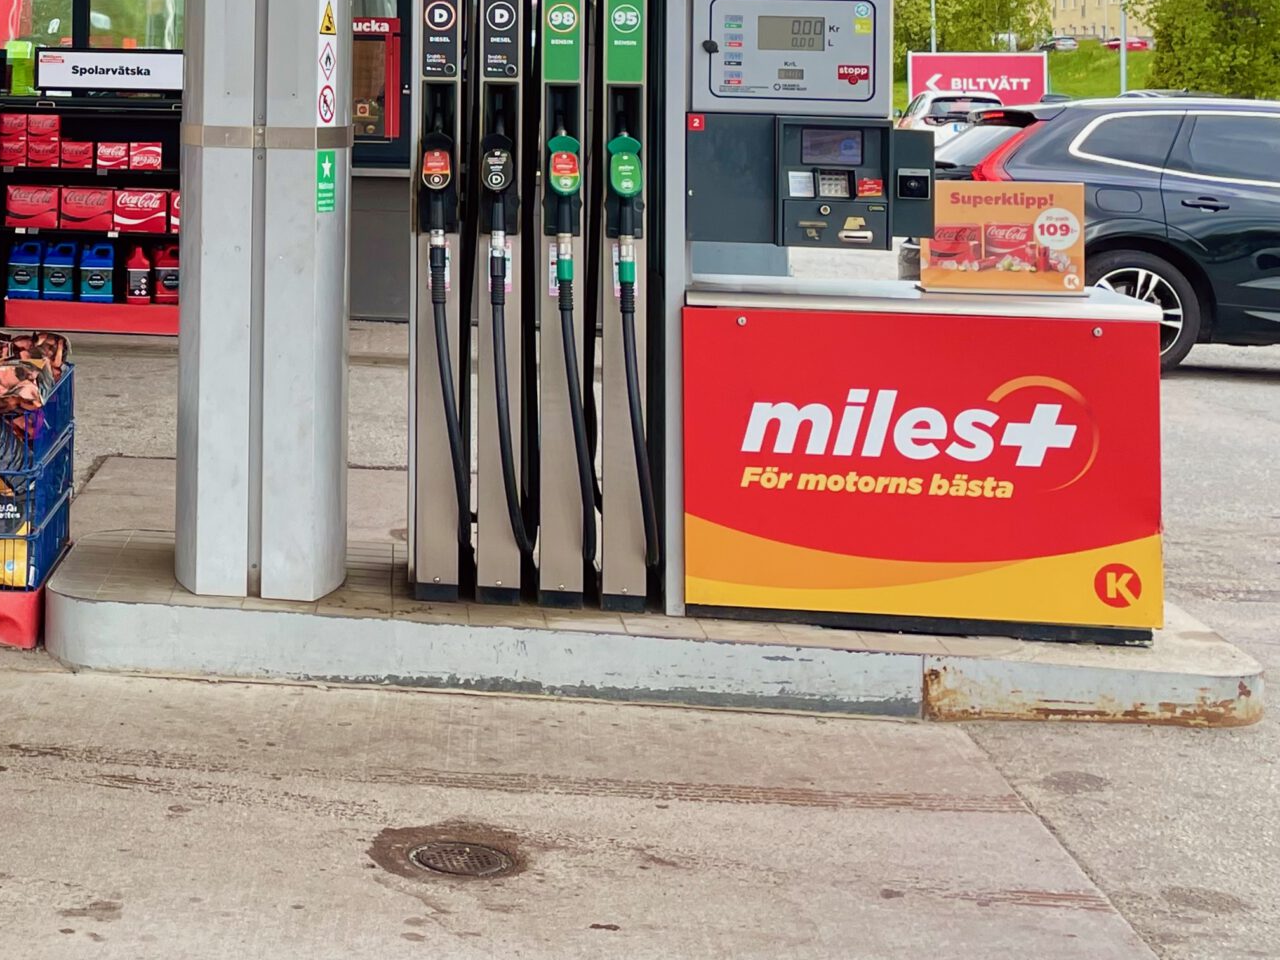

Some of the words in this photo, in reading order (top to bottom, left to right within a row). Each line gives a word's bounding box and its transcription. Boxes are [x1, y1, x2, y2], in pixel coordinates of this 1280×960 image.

[434, 9, 448, 23] D
[494, 9, 509, 23] D
[550, 11, 575, 26] 98
[613, 11, 638, 26] 95
[353, 19, 390, 32] ucka
[828, 25, 840, 33] Kr
[71, 65, 151, 76] Spolarvätska
[838, 67, 868, 76] stopp
[951, 75, 1031, 91] BILTVÄTT
[692, 118, 701, 127] 2
[492, 175, 501, 184] D
[950, 192, 1054, 209] Superklipp!
[741, 388, 1078, 468] miles+
[740, 466, 793, 490] För
[796, 471, 924, 496] motorns
[928, 472, 1015, 499] bästa
[1100, 568, 1138, 607] K
